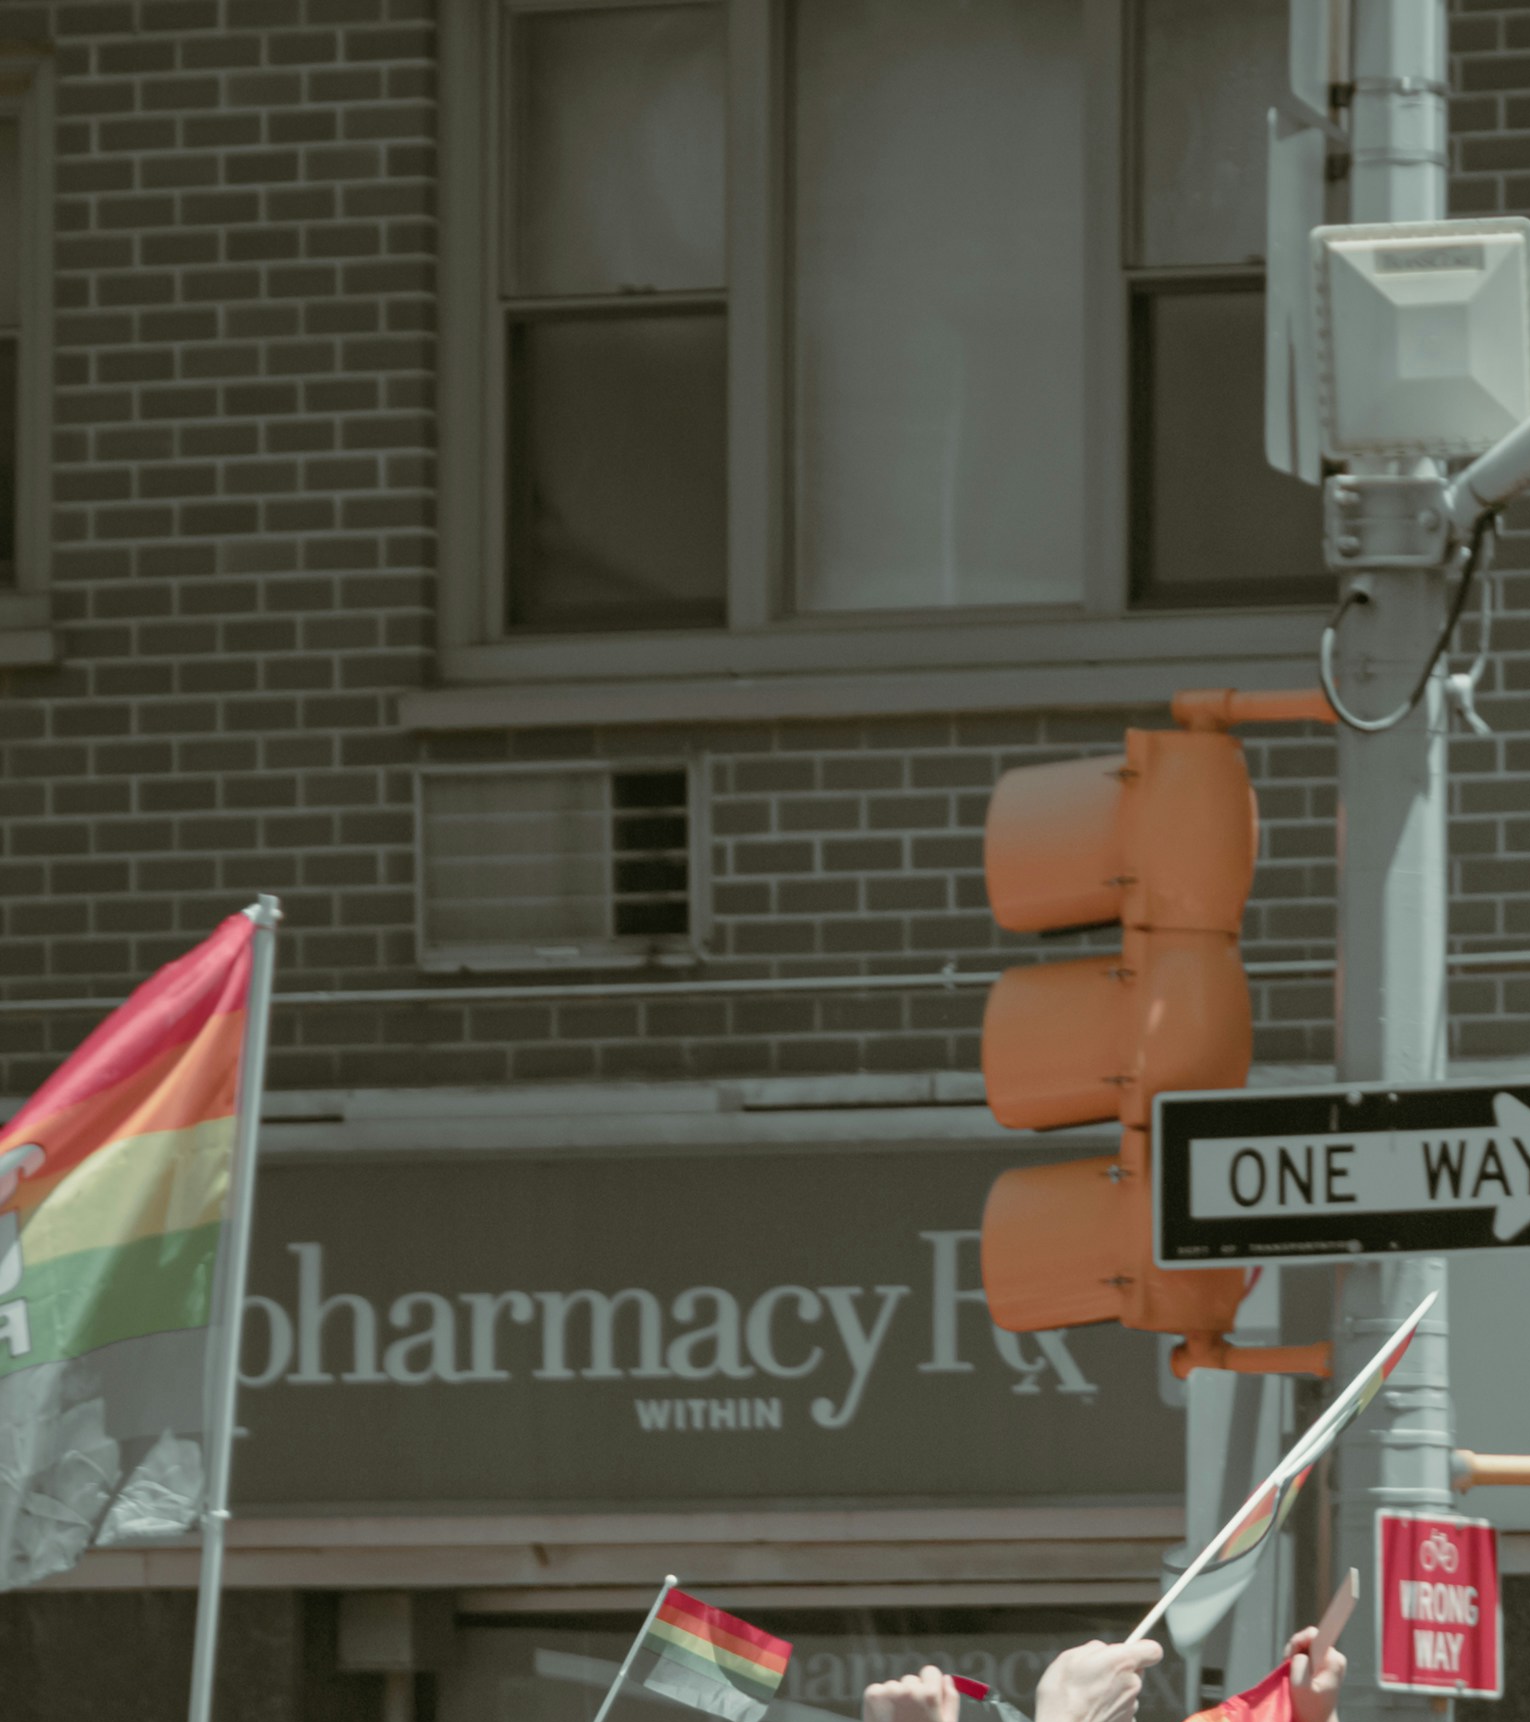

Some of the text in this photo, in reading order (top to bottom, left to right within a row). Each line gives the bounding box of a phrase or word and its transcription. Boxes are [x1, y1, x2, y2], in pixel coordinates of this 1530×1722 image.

[1229, 1144, 1357, 1207] ONE
[635, 1398, 783, 1431] WITHIN
[1399, 1579, 1479, 1627] WRONG
[1413, 1629, 1465, 1672] WAY
